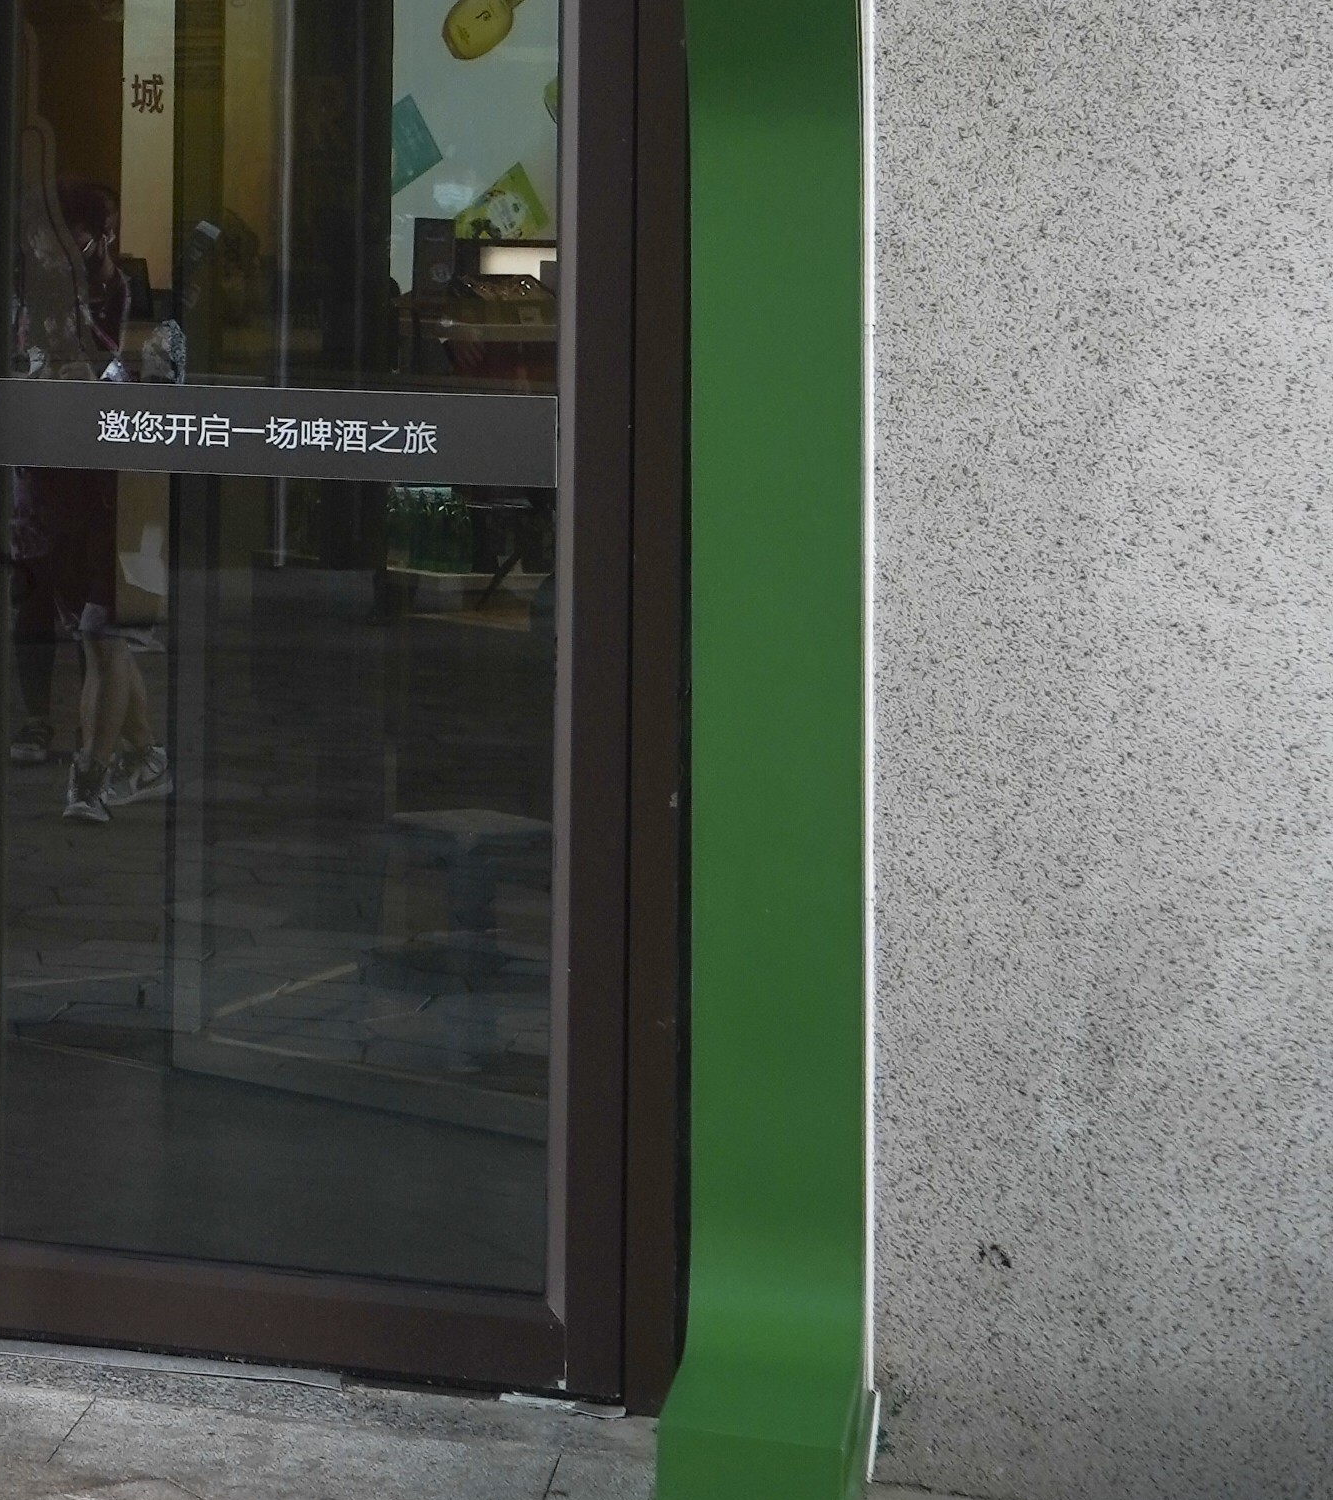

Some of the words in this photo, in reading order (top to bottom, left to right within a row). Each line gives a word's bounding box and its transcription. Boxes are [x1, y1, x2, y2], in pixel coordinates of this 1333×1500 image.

[96, 408, 438, 455] 邀您开启一场啤酒之旅
